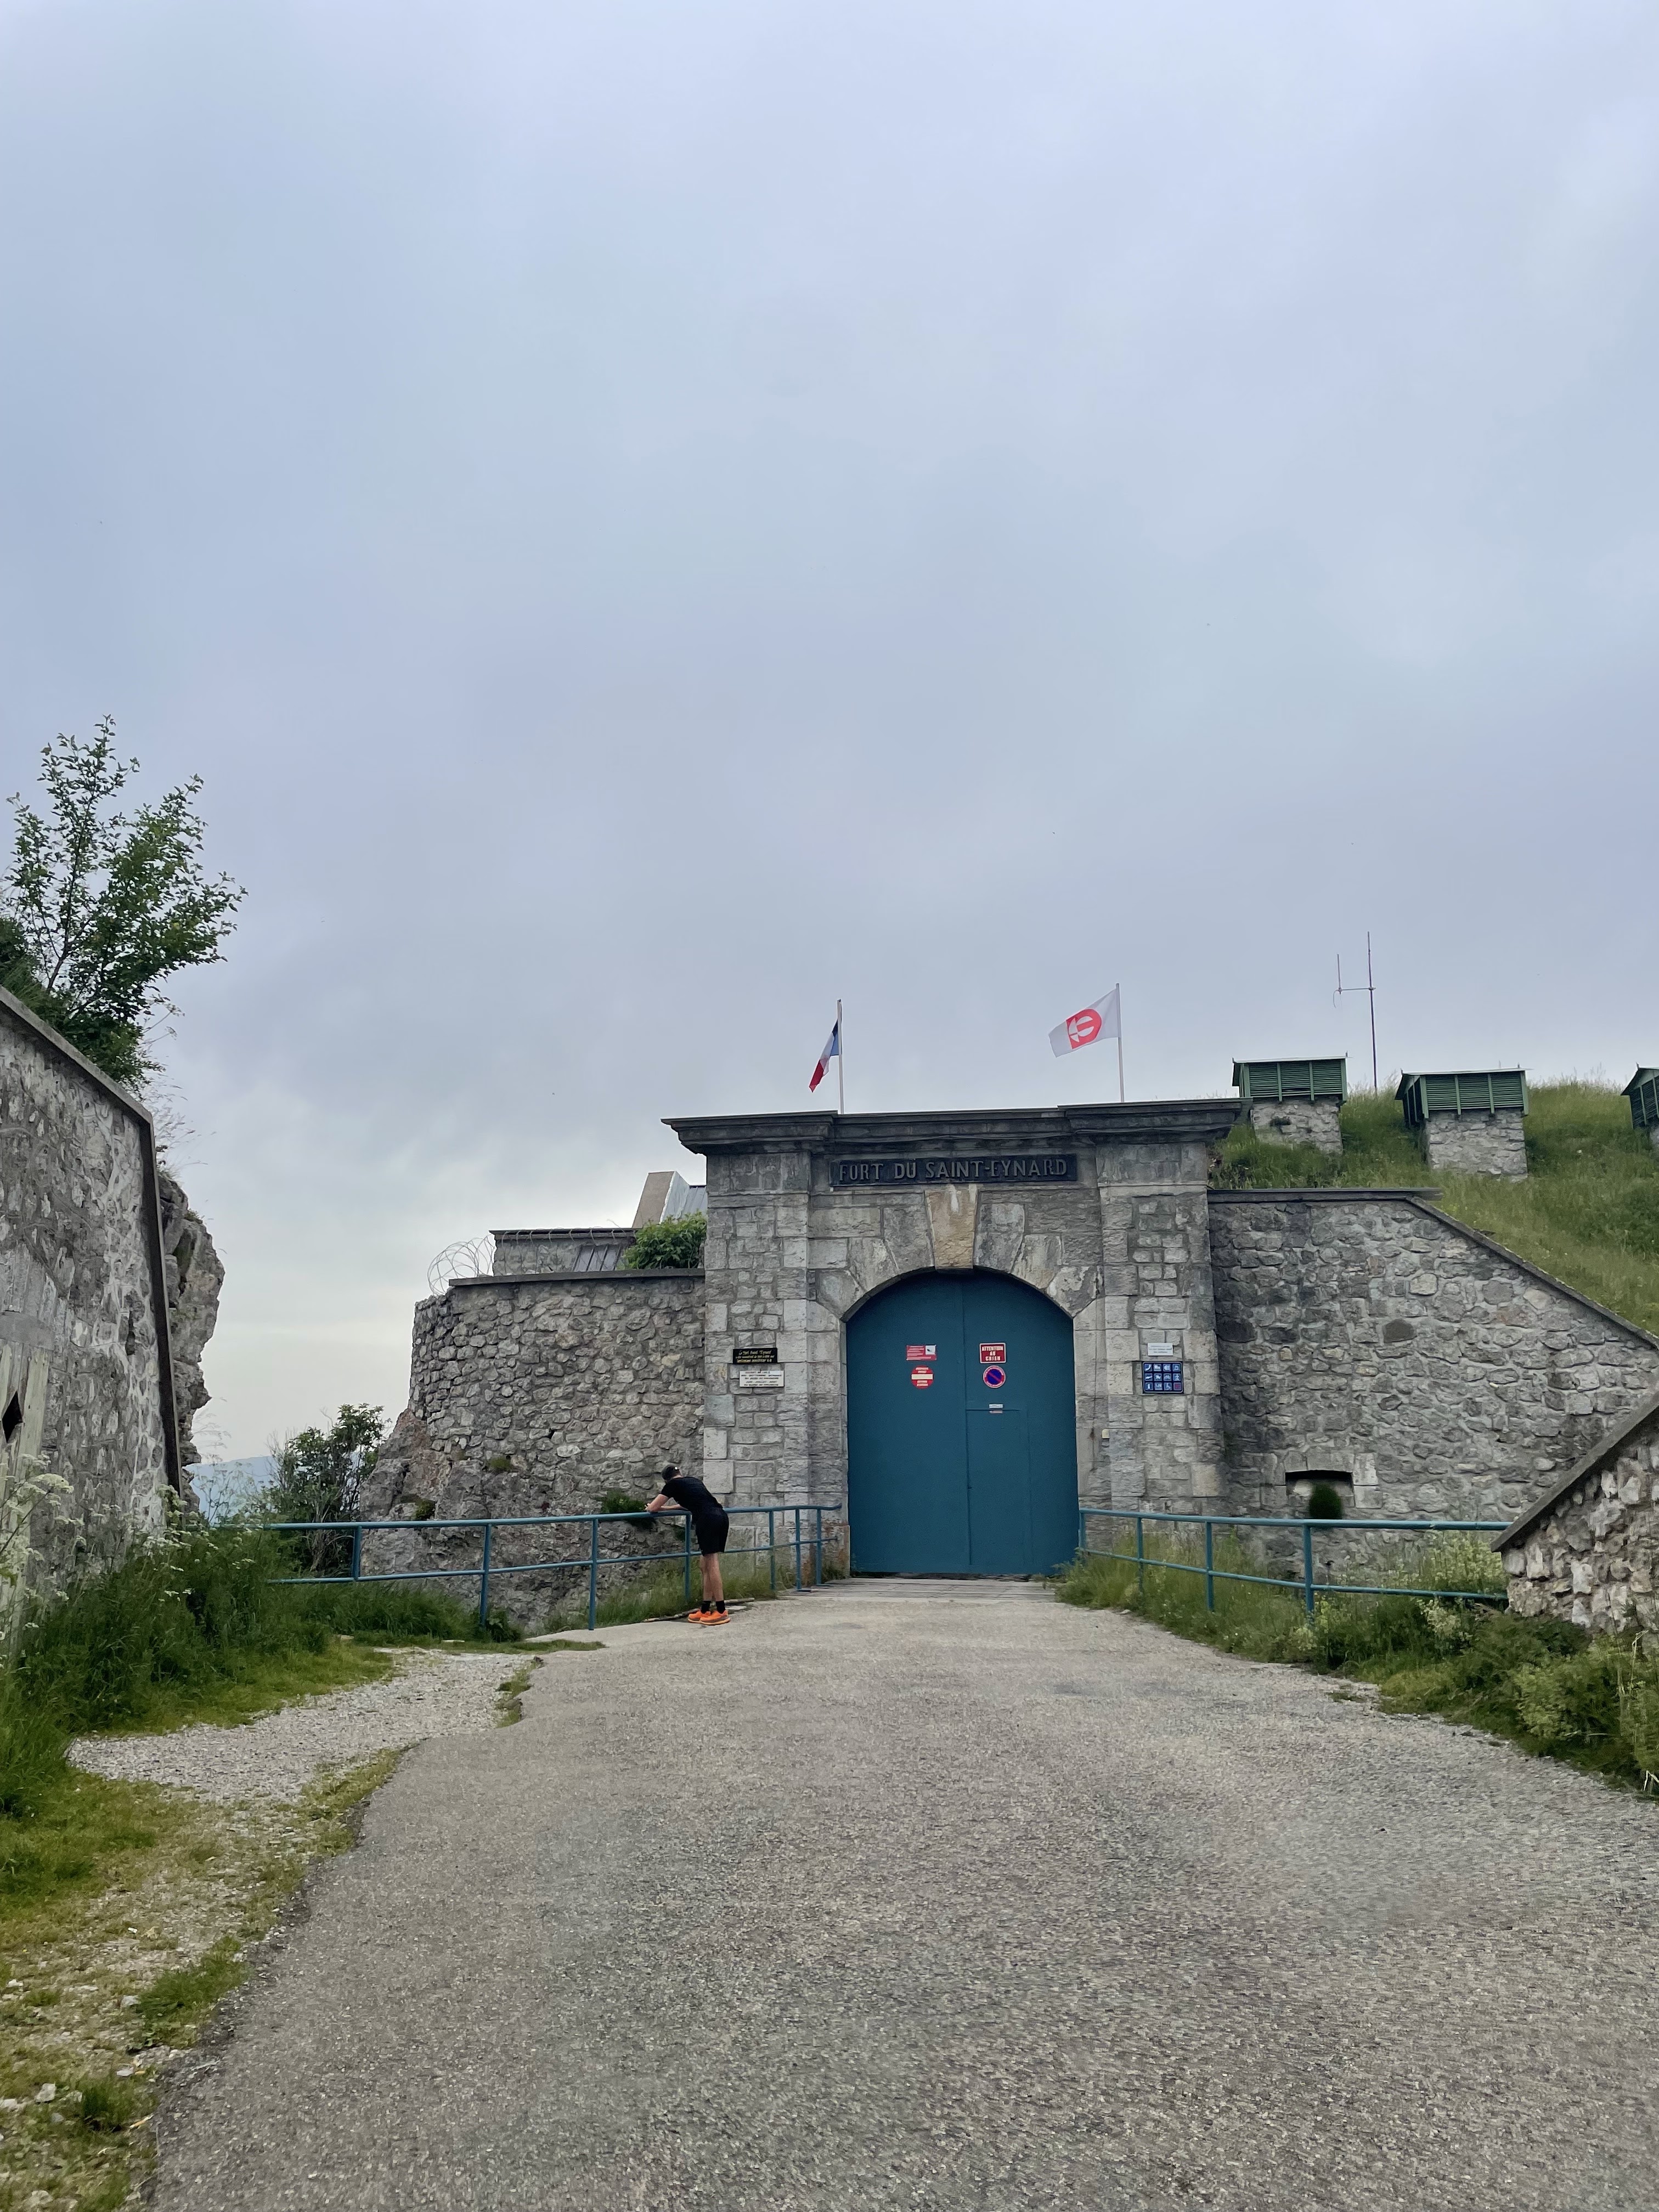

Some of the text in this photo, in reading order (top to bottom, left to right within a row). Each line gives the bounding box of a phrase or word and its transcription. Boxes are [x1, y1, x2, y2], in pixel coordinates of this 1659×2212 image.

[839, 1159, 1068, 1181] FORT DU SAINT-EYNARD
